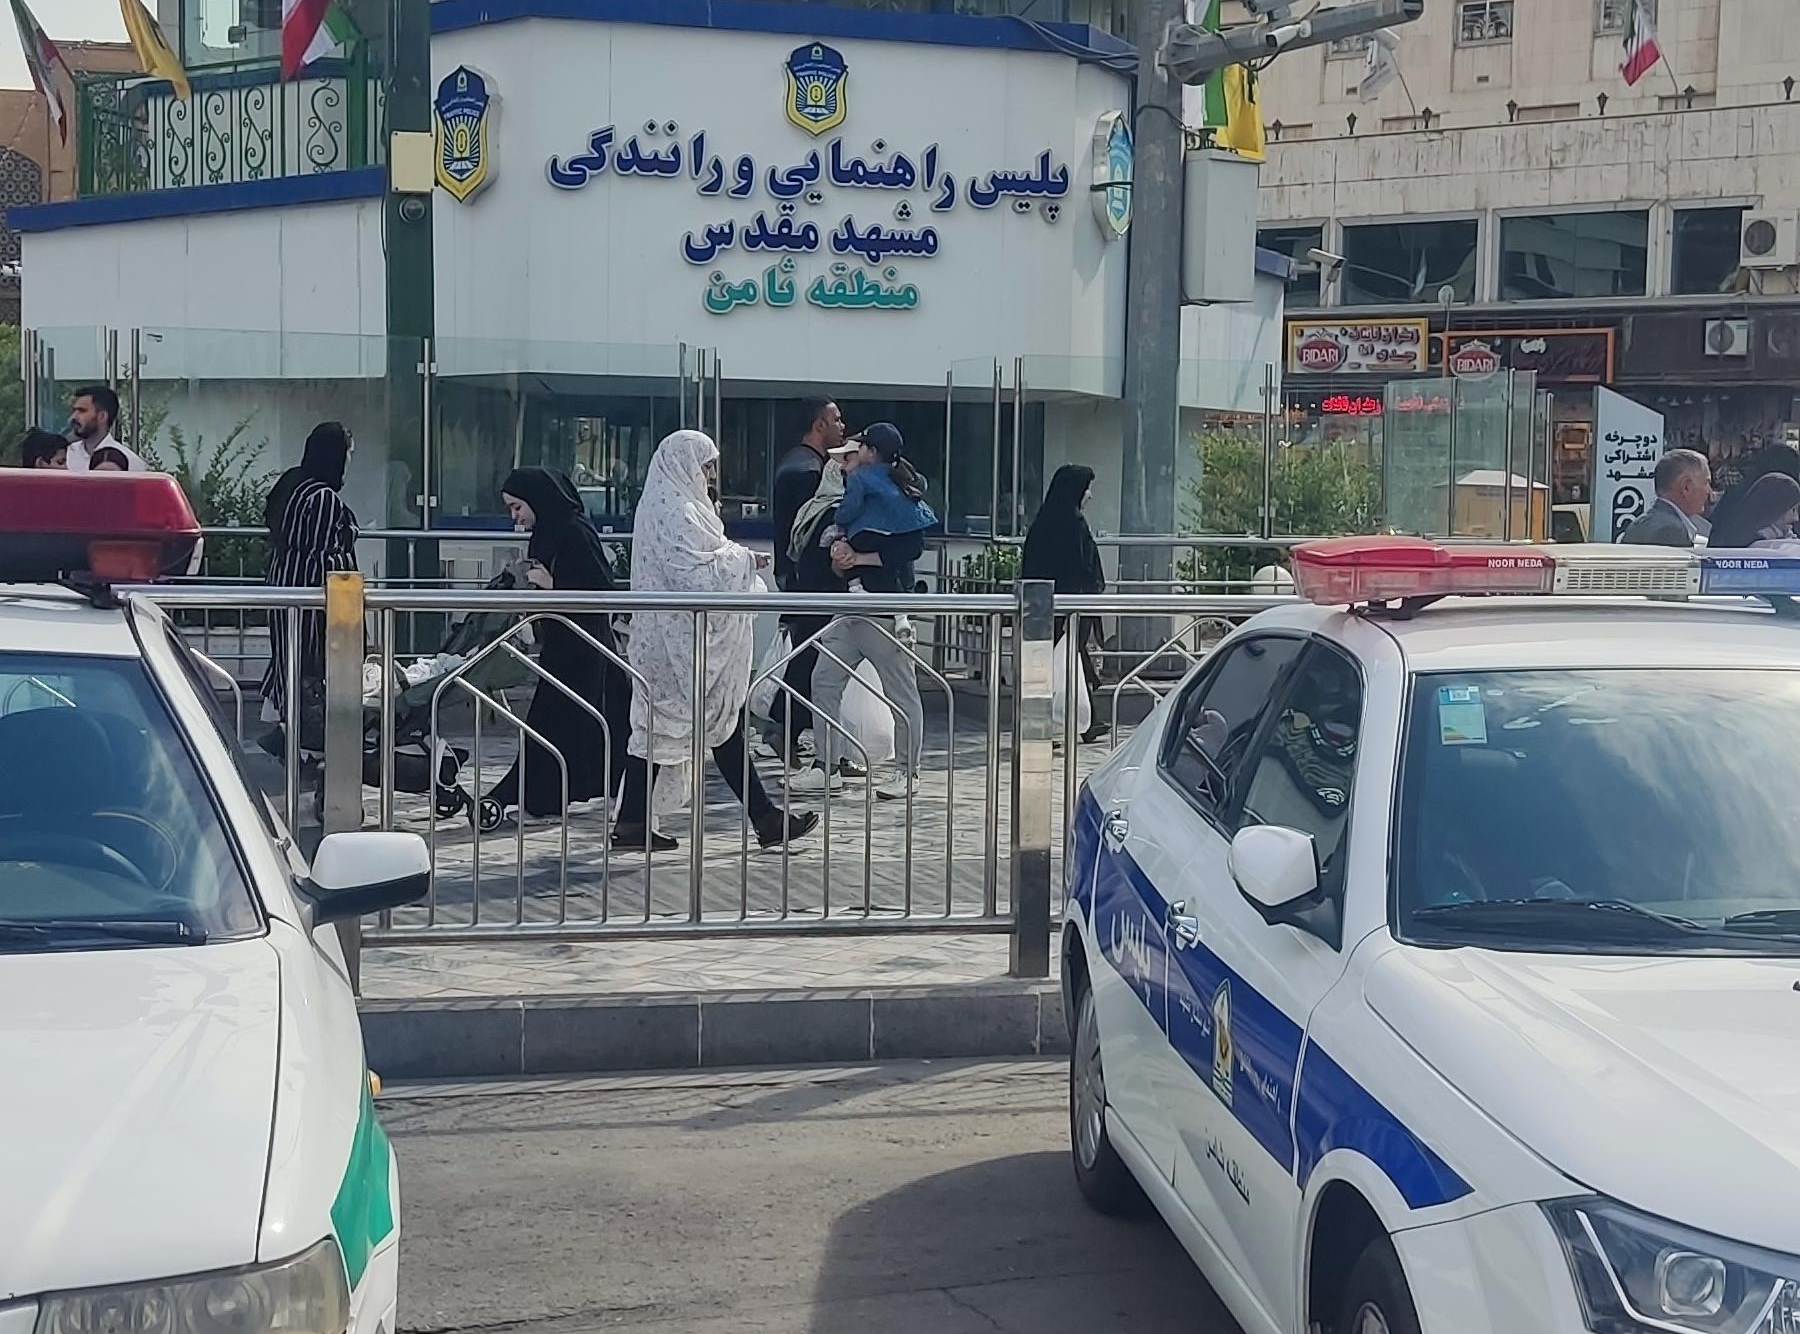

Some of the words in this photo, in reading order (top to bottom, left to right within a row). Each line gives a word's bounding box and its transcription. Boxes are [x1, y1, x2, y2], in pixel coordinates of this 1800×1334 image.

[547, 119, 726, 196] رانندگی
[768, 137, 956, 211] راهنمایی
[968, 149, 1070, 223] پلیس
[682, 201, 820, 265] مقدس
[830, 201, 939, 265] مشهد
[703, 255, 797, 314] ثامن
[807, 262, 920, 309] منطقه
[1302, 348, 1339, 364] BIDARI
[1456, 358, 1494, 372] BIDARI
[1604, 430, 1658, 449] دوچرخه
[1604, 449, 1656, 465] اشتراکی
[1606, 466, 1656, 482] مشهد
[1488, 558, 1516, 568] NOOR
[1517, 558, 1543, 568] NEDA
[1715, 560, 1742, 569] NOOR
[1743, 560, 1769, 569] NEDA
[1110, 909, 1152, 1008] پلیس
